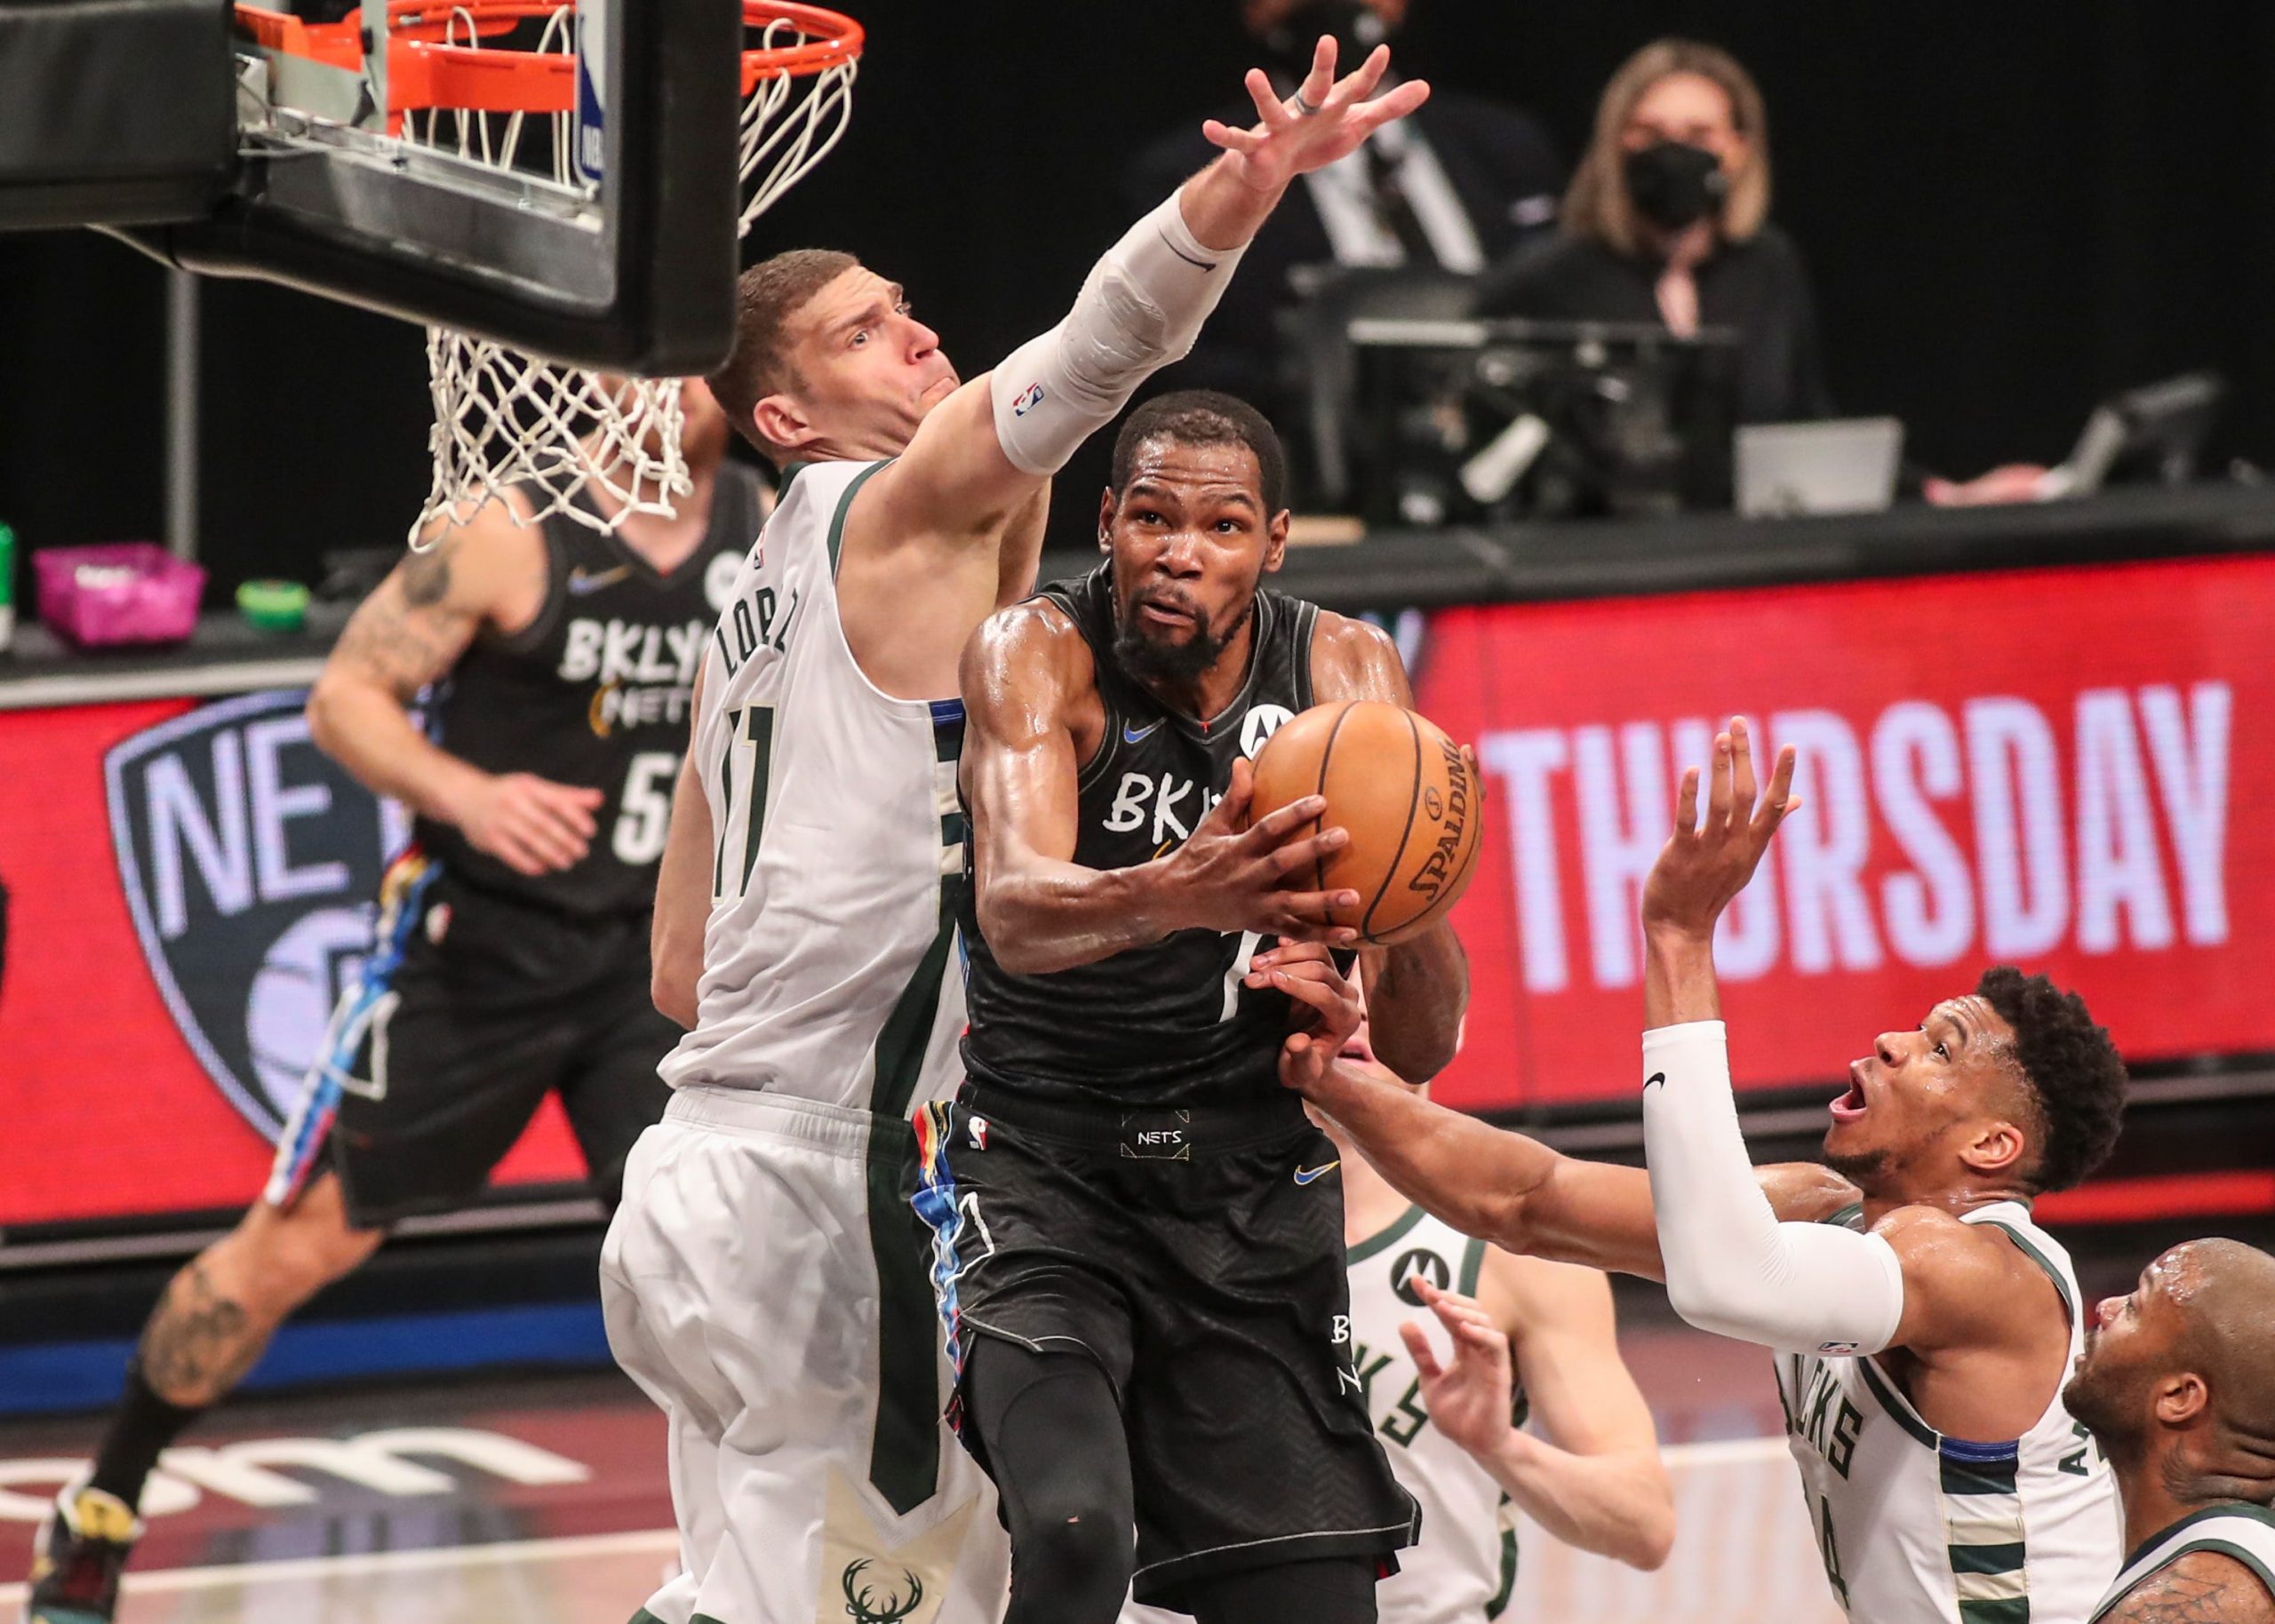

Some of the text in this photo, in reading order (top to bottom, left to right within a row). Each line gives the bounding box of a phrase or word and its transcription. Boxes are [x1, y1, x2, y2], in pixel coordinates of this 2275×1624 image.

[582, 124, 604, 171] NB
[558, 618, 711, 682] BKLY
[599, 684, 694, 728] NET
[143, 716, 350, 940] NE
[611, 752, 682, 864] 5
[1479, 680, 2232, 994] THURSDAY
[1138, 1130, 1182, 1145] NETS
